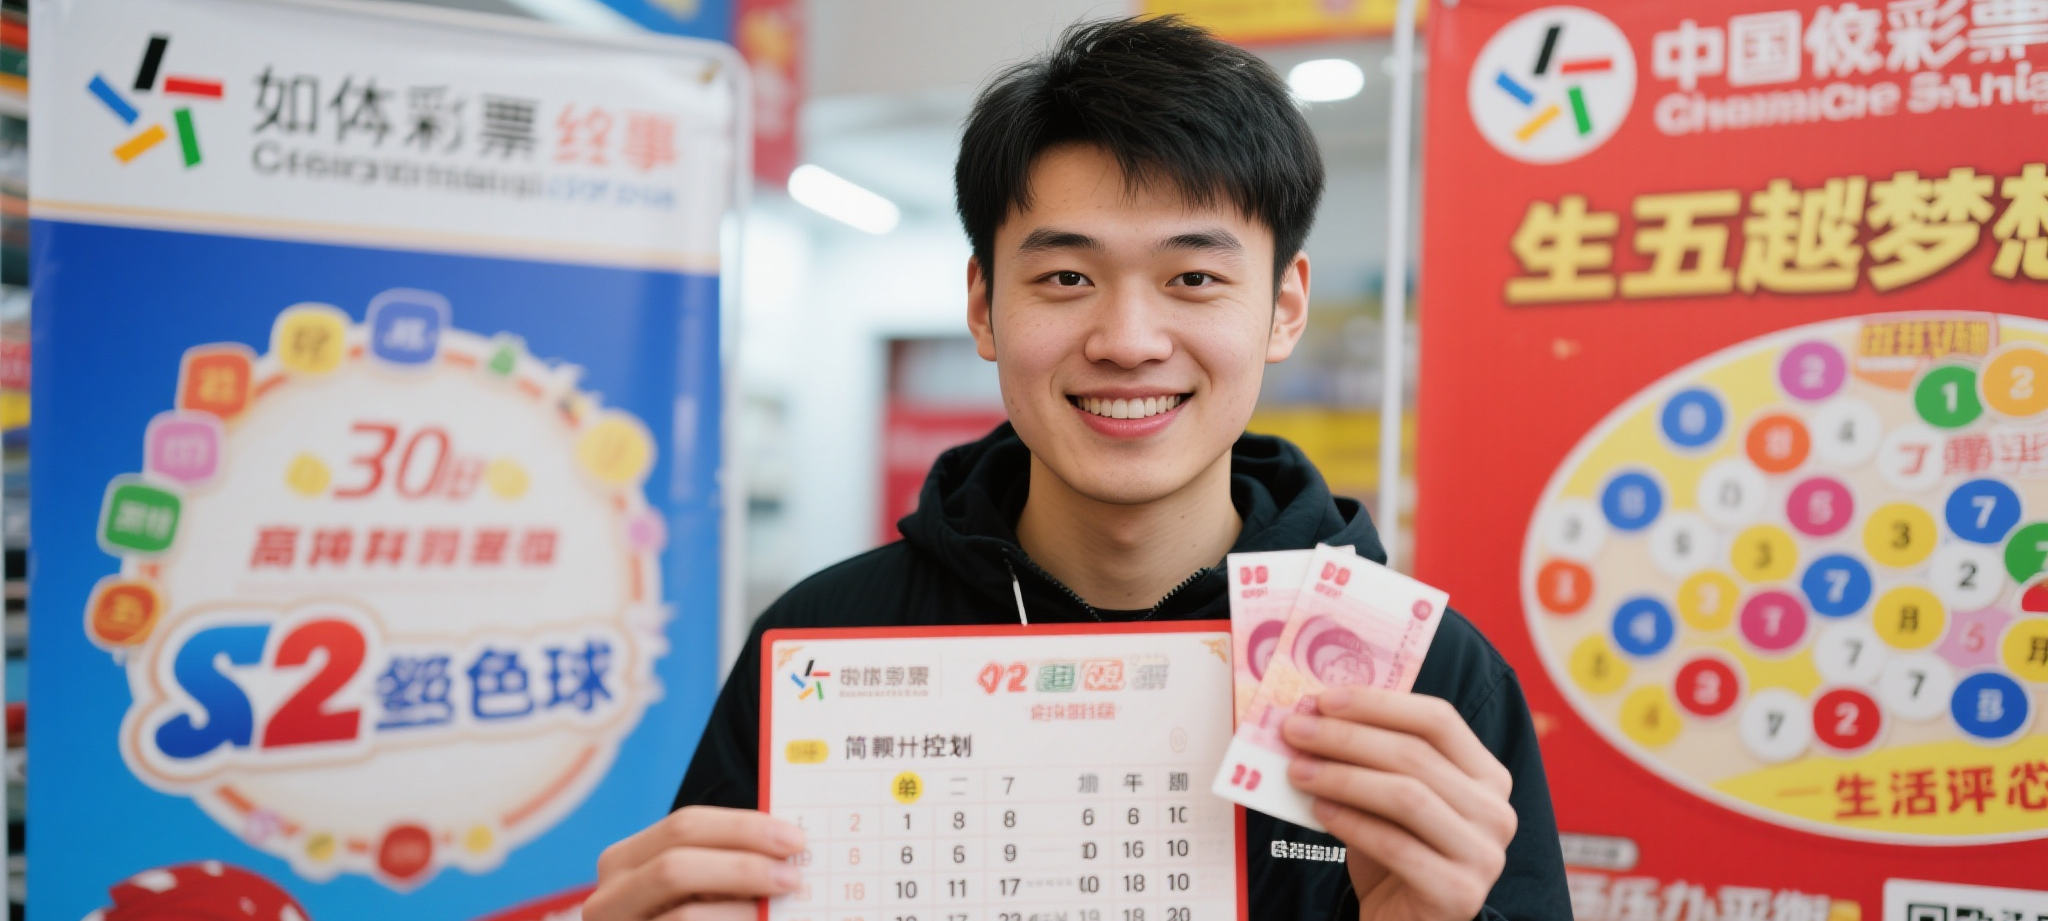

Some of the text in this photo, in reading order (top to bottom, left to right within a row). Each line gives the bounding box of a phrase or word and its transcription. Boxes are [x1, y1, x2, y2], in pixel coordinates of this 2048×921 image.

[1941, 381, 1958, 413] 1
[1971, 495, 1997, 529] 7
[1891, 521, 1911, 549] 3
[1823, 570, 1849, 602] 7
[1959, 562, 1977, 590] 2
[155, 618, 367, 759] S2
[1909, 671, 1925, 696] 7
[1834, 702, 1858, 735] 2
[903, 813, 911, 829] 1
[1004, 811, 1015, 827] 8
[1083, 809, 1094, 825] 6
[901, 847, 913, 863] 6
[1004, 844, 1016, 861] 9
[1124, 841, 1144, 858] 16
[1168, 840, 1188, 856] 10
[895, 881, 917, 898] 10
[948, 879, 966, 897] 11
[1000, 878, 1020, 896] 17
[1168, 873, 1189, 891] 10
